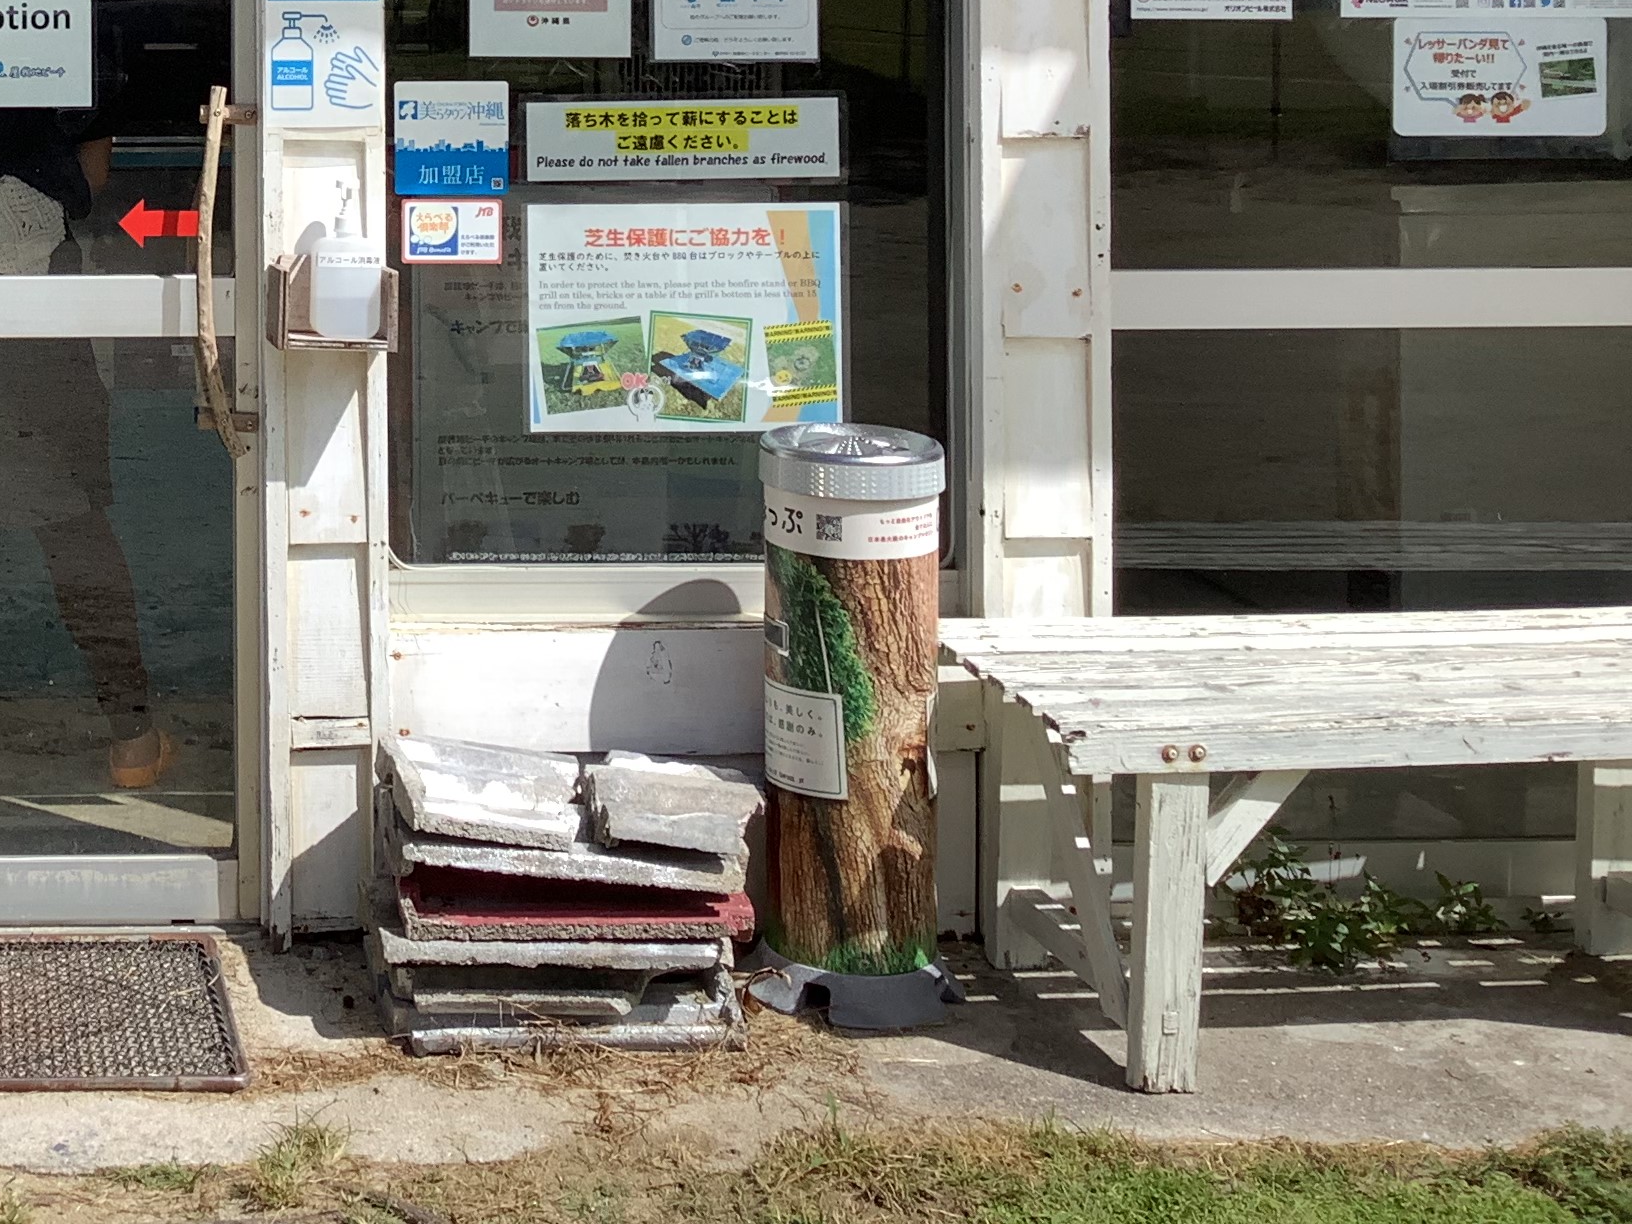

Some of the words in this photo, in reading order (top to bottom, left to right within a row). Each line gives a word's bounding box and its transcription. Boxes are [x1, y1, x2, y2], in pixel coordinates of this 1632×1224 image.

[565, 109, 798, 128] 落ち木を拾って薪にすることは
[617, 134, 740, 151] ご遠慮ください。
[536, 156, 576, 168] Please
[579, 157, 594, 167] do
[597, 156, 618, 167] not
[622, 155, 650, 167] take
[654, 155, 689, 166] fallen
[692, 154, 748, 166] branches
[752, 156, 766, 165] as
[419, 165, 484, 184] 加盟店
[539, 281, 548, 289] In
[550, 280, 574, 289] order
[576, 281, 585, 289] to
[587, 280, 618, 291] protect
[621, 280, 635, 289] the
[664, 280, 692, 291] please
[694, 280, 708, 290] put
[711, 279, 725, 288] the
[728, 278, 759, 288] bonfire
[761, 279, 785, 287] stand
[800, 279, 821, 289] BBQ
[539, 291, 557, 301] grill
[596, 291, 624, 299] bricks
[645, 291, 668, 299] table
[678, 290, 692, 299] the
[721, 290, 752, 298] bottom
[754, 290, 762, 298] is
[764, 290, 781, 298] less
[554, 301, 575, 310] from
[577, 302, 592, 310] the
[594, 302, 627, 312] ground.
[621, 372, 648, 390] OK
